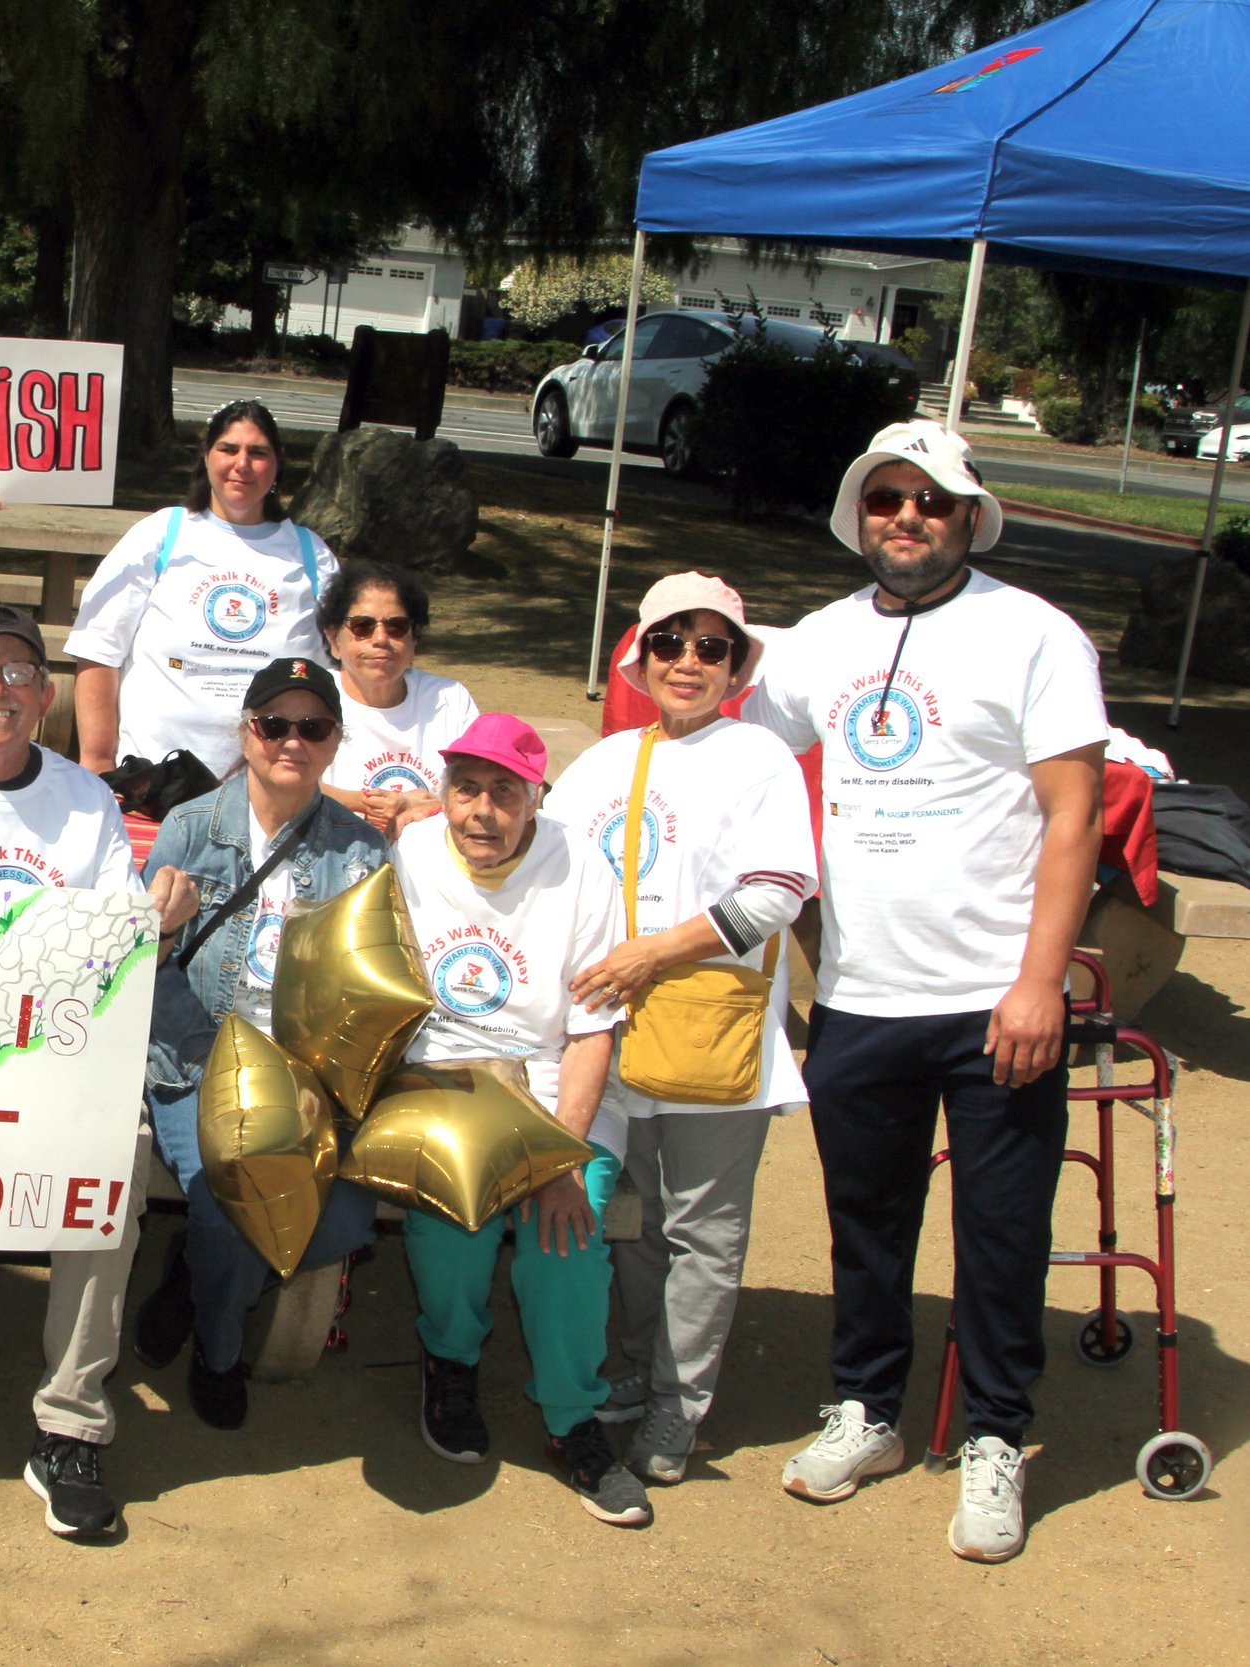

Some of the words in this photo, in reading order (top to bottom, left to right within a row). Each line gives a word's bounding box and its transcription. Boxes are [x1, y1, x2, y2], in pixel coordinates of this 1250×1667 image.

[188, 580, 210, 605] 2025
[209, 571, 239, 582] Walk
[244, 572, 266, 590] This
[267, 588, 279, 616] Way
[239, 649, 271, 658] disability.
[827, 691, 850, 730] 2025
[851, 668, 891, 691] Walk
[897, 669, 924, 692] This
[922, 690, 942, 727] Way
[848, 691, 900, 724] AWARENSS
[901, 699, 917, 722] WALK
[364, 751, 395, 771] Walk
[398, 752, 422, 770] This
[423, 768, 439, 786] Wa
[373, 768, 408, 786] ARENESS
[868, 758, 891, 767] Respect
[840, 777, 851, 785] See
[851, 777, 863, 785] ME,
[878, 779, 890, 787] my
[891, 777, 935, 787] disability.
[587, 810, 606, 838] 025
[609, 795, 630, 810] Wa
[647, 789, 668, 811] This
[664, 810, 678, 844] Way
[14, 847, 46, 871] This
[48, 867, 65, 887] Wa
[422, 937, 446, 961] 025
[447, 924, 483, 941] Walk
[487, 927, 512, 953] This
[512, 950, 529, 985] Way
[440, 945, 491, 971] AWARENESS
[491, 957, 508, 982] WALK
[450, 984, 467, 993] Serra
[468, 987, 491, 997] Center
[15, 994, 90, 1056] IS
[455, 1004, 480, 1013] Respect
